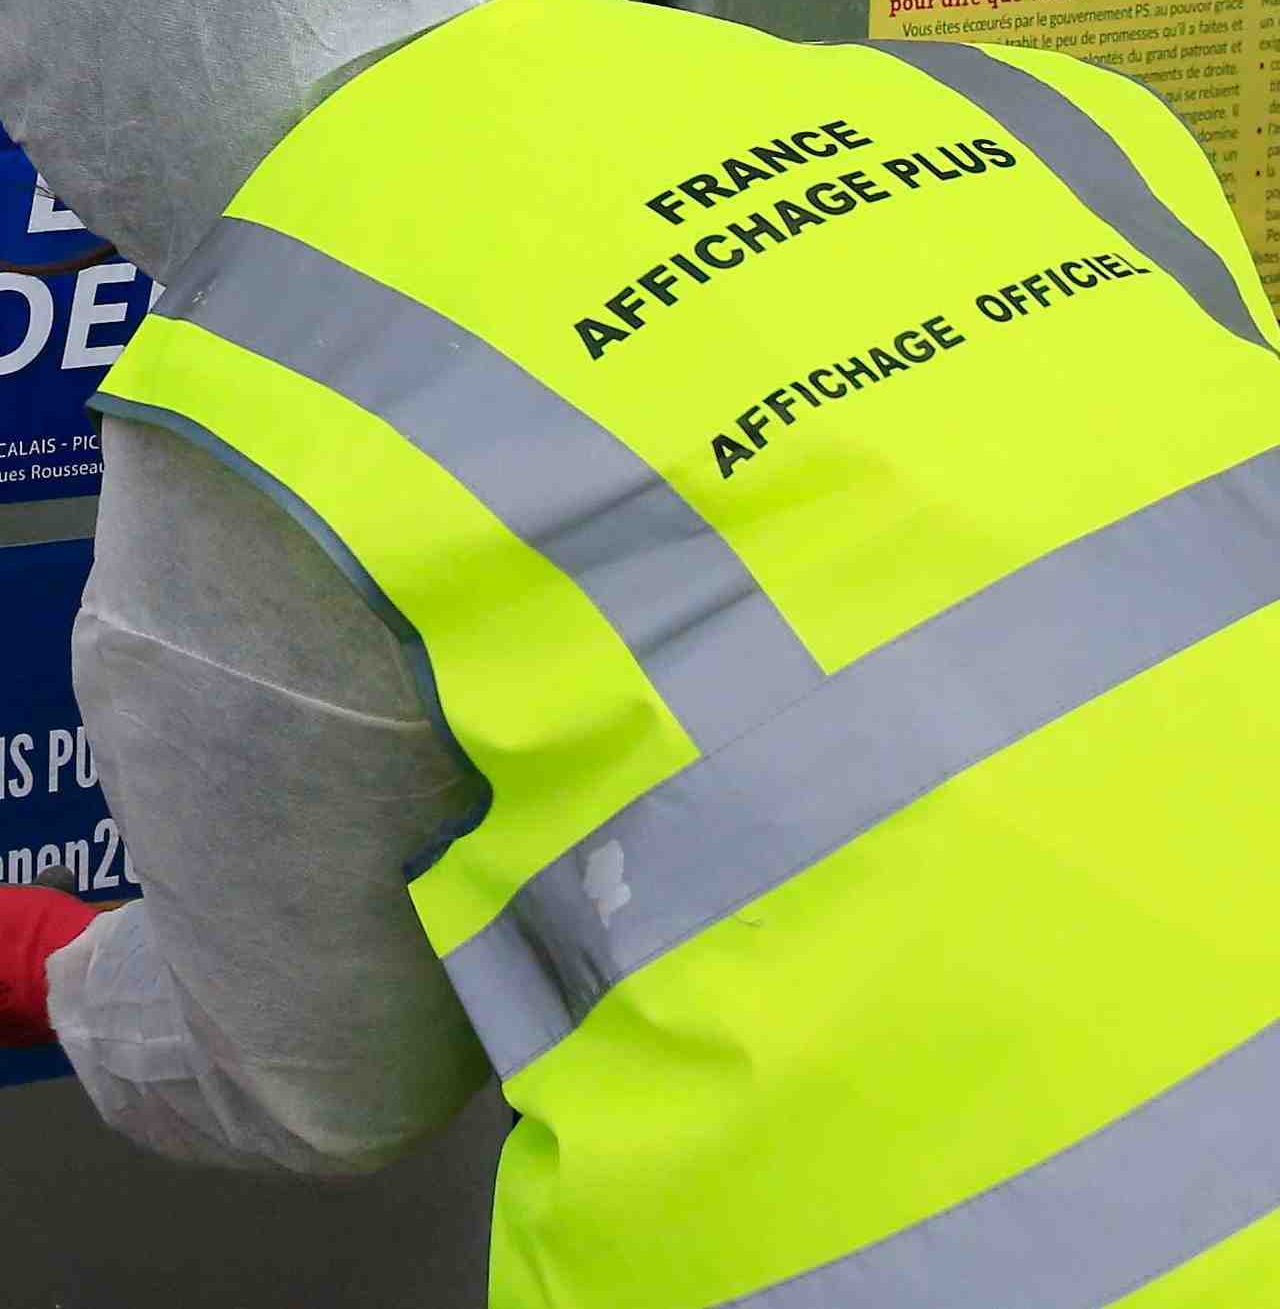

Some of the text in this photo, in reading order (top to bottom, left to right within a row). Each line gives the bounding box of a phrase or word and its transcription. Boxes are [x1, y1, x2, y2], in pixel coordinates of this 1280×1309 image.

[574, 171, 891, 361] AFFICHAGE
[883, 138, 1017, 190] PLUS
[645, 120, 874, 226] FRANCE
[708, 252, 1152, 480] AFFICHAGE OFFICIEL
